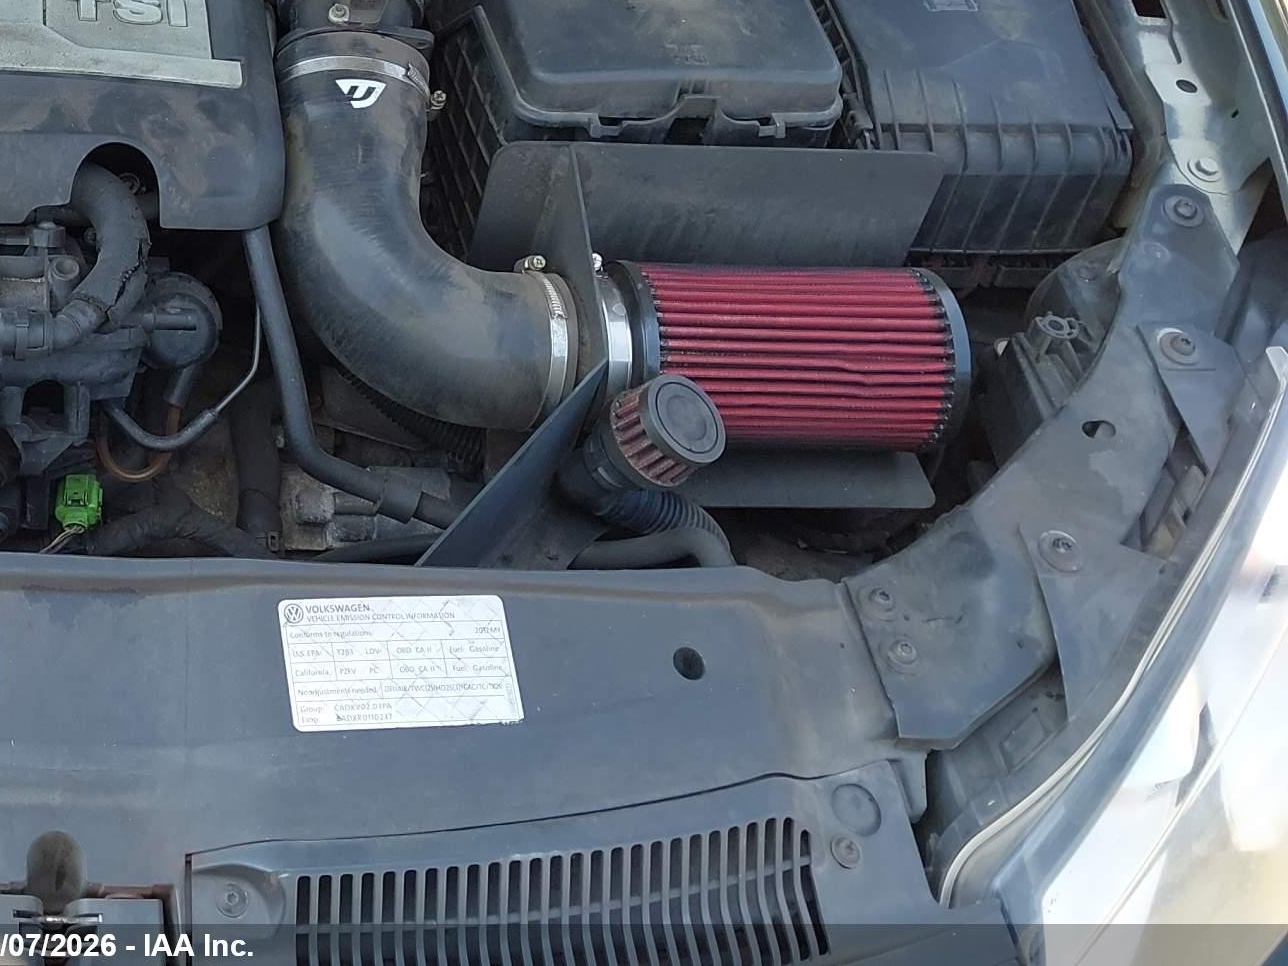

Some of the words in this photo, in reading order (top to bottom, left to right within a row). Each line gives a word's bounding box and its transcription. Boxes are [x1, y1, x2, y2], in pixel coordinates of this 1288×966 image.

[305, 604, 370, 614] VOLKSWAGEN
[307, 614, 334, 622] VEHICLE
[336, 613, 370, 622] EMISSION
